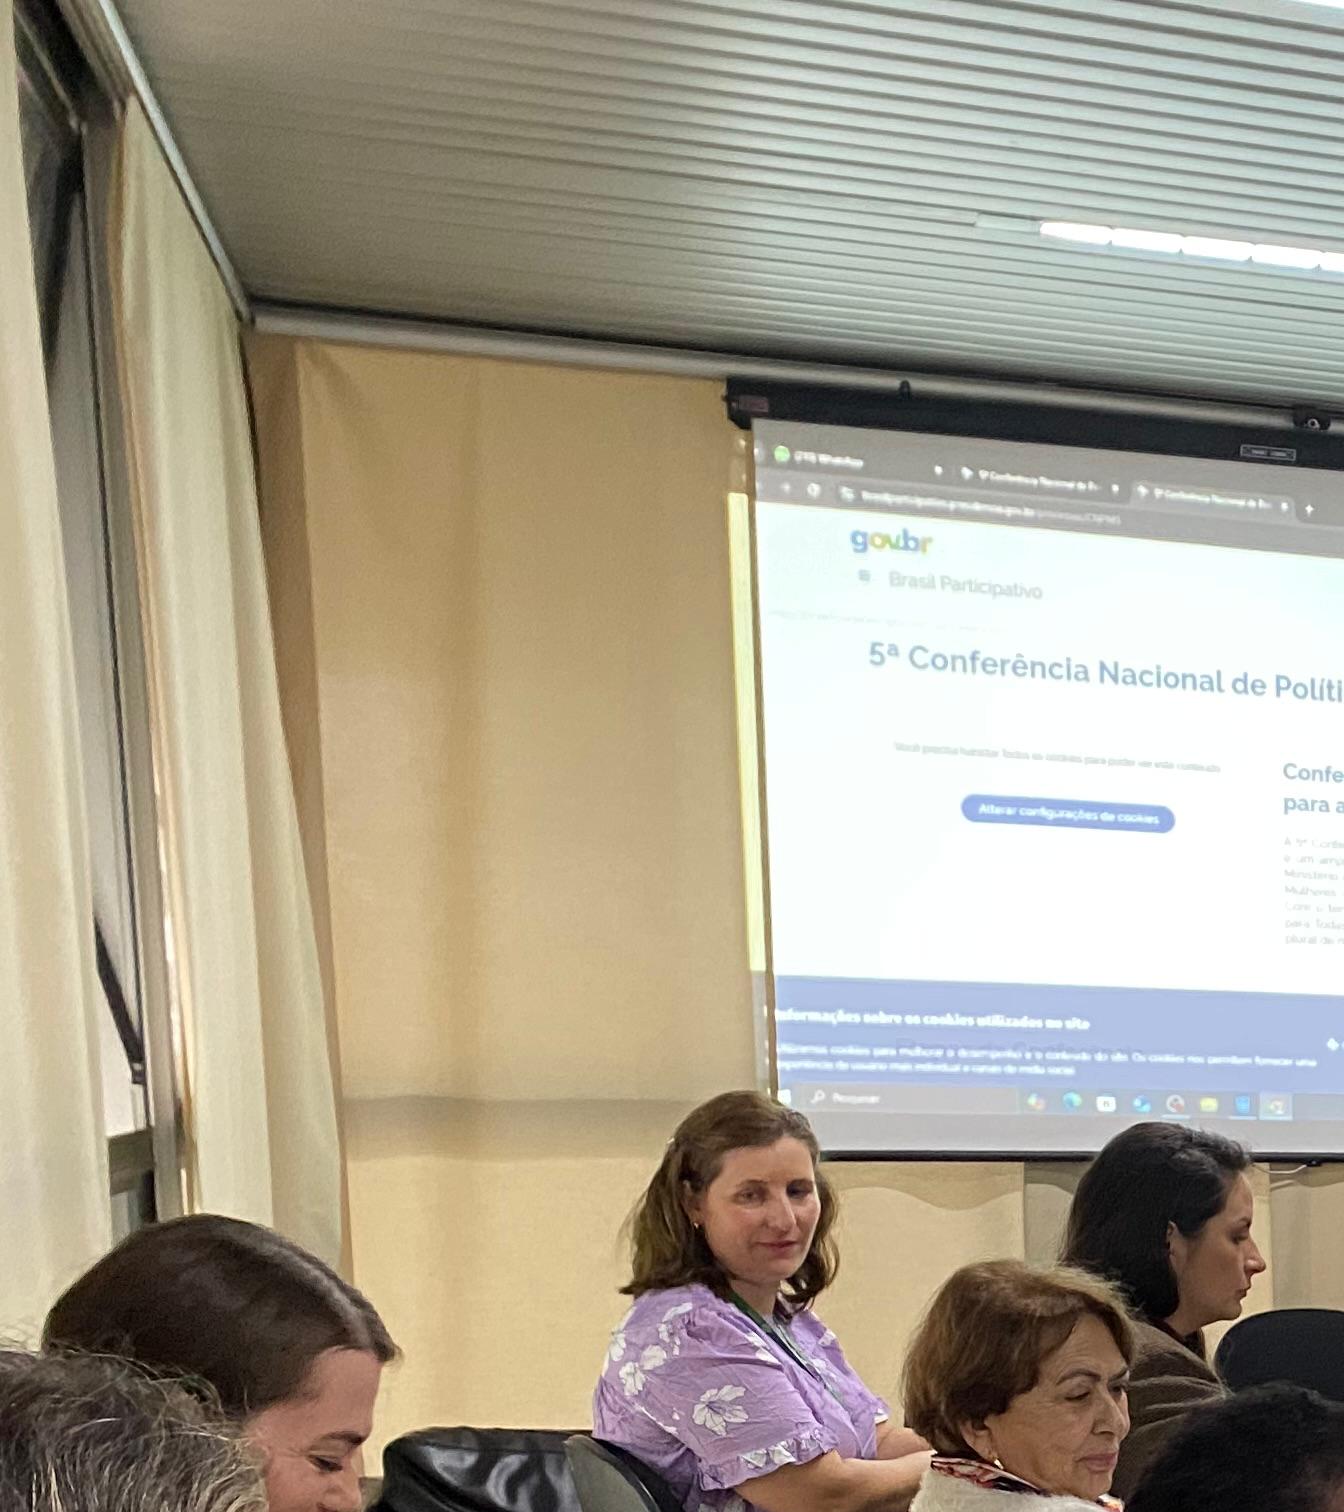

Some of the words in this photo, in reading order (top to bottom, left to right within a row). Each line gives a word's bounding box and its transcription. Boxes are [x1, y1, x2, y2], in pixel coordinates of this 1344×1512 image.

[889, 571, 936, 591] Brasil
[940, 574, 1043, 601] Participativo
[869, 641, 899, 667] 5ª
[909, 645, 1090, 683] Conferência
[1100, 660, 1225, 694] Nacional
[1231, 669, 1266, 698] de
[1018, 806, 1099, 823] configurações
[1099, 811, 1115, 822] de
[1116, 813, 1160, 825] cookies
[1283, 796, 1331, 816] para
[774, 1008, 861, 1027] nformações
